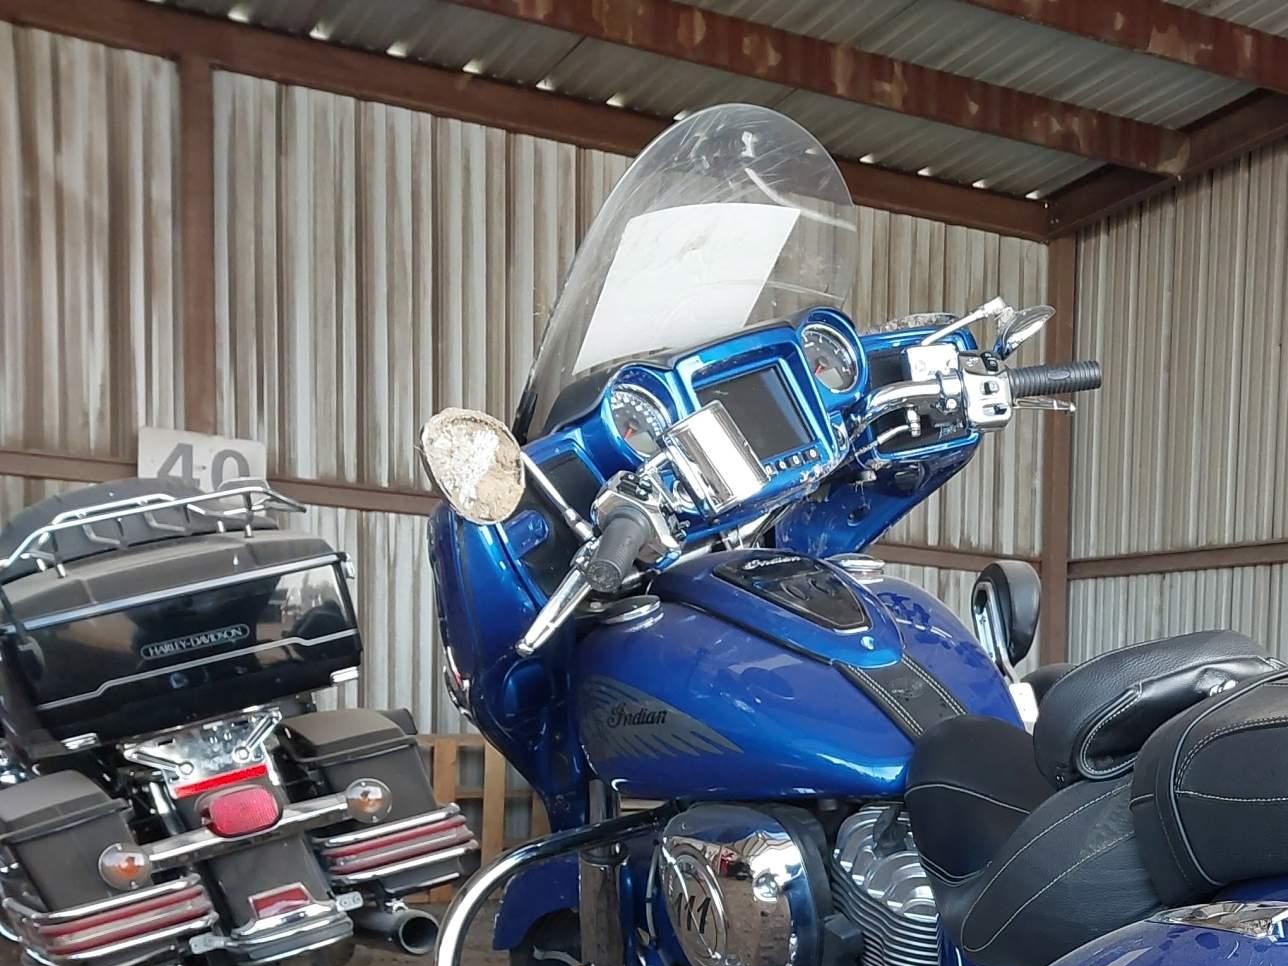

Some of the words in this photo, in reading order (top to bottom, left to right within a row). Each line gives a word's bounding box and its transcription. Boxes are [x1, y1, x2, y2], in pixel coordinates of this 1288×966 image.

[157, 443, 250, 491] 40
[148, 627, 243, 657] HARLEY-DAVIDSON
[607, 703, 668, 729] Indian
